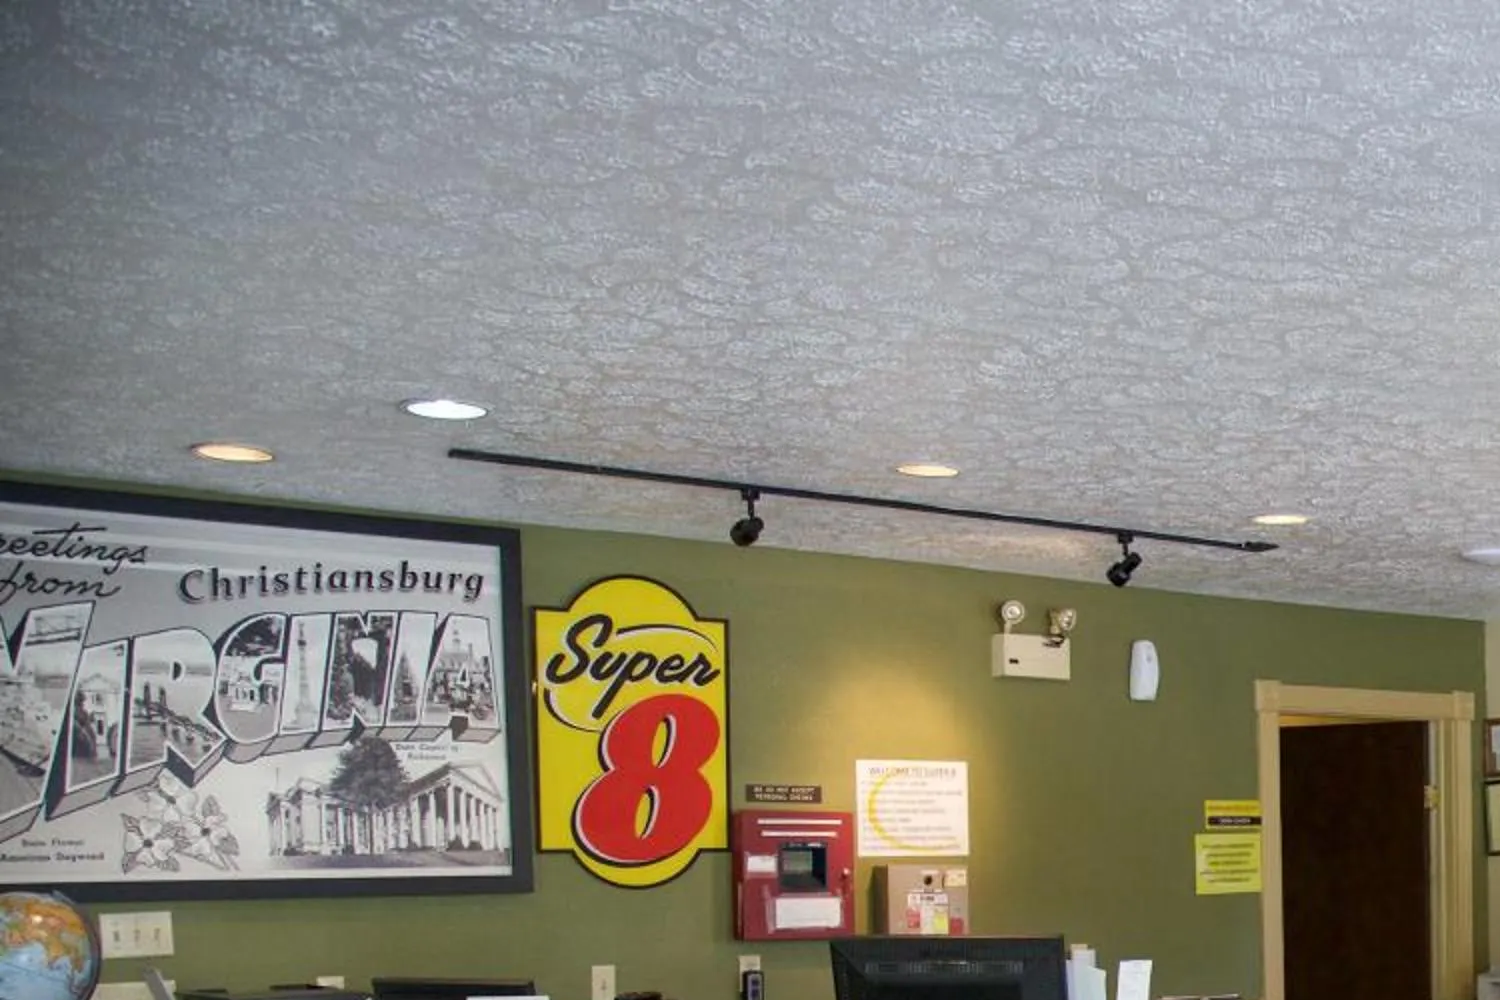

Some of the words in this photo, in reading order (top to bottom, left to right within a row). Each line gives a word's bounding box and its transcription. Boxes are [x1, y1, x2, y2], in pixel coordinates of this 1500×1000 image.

[0, 560, 121, 606] from
[178, 560, 484, 602] Christiansburg
[546, 613, 720, 720] Super
[571, 692, 721, 868] 8
